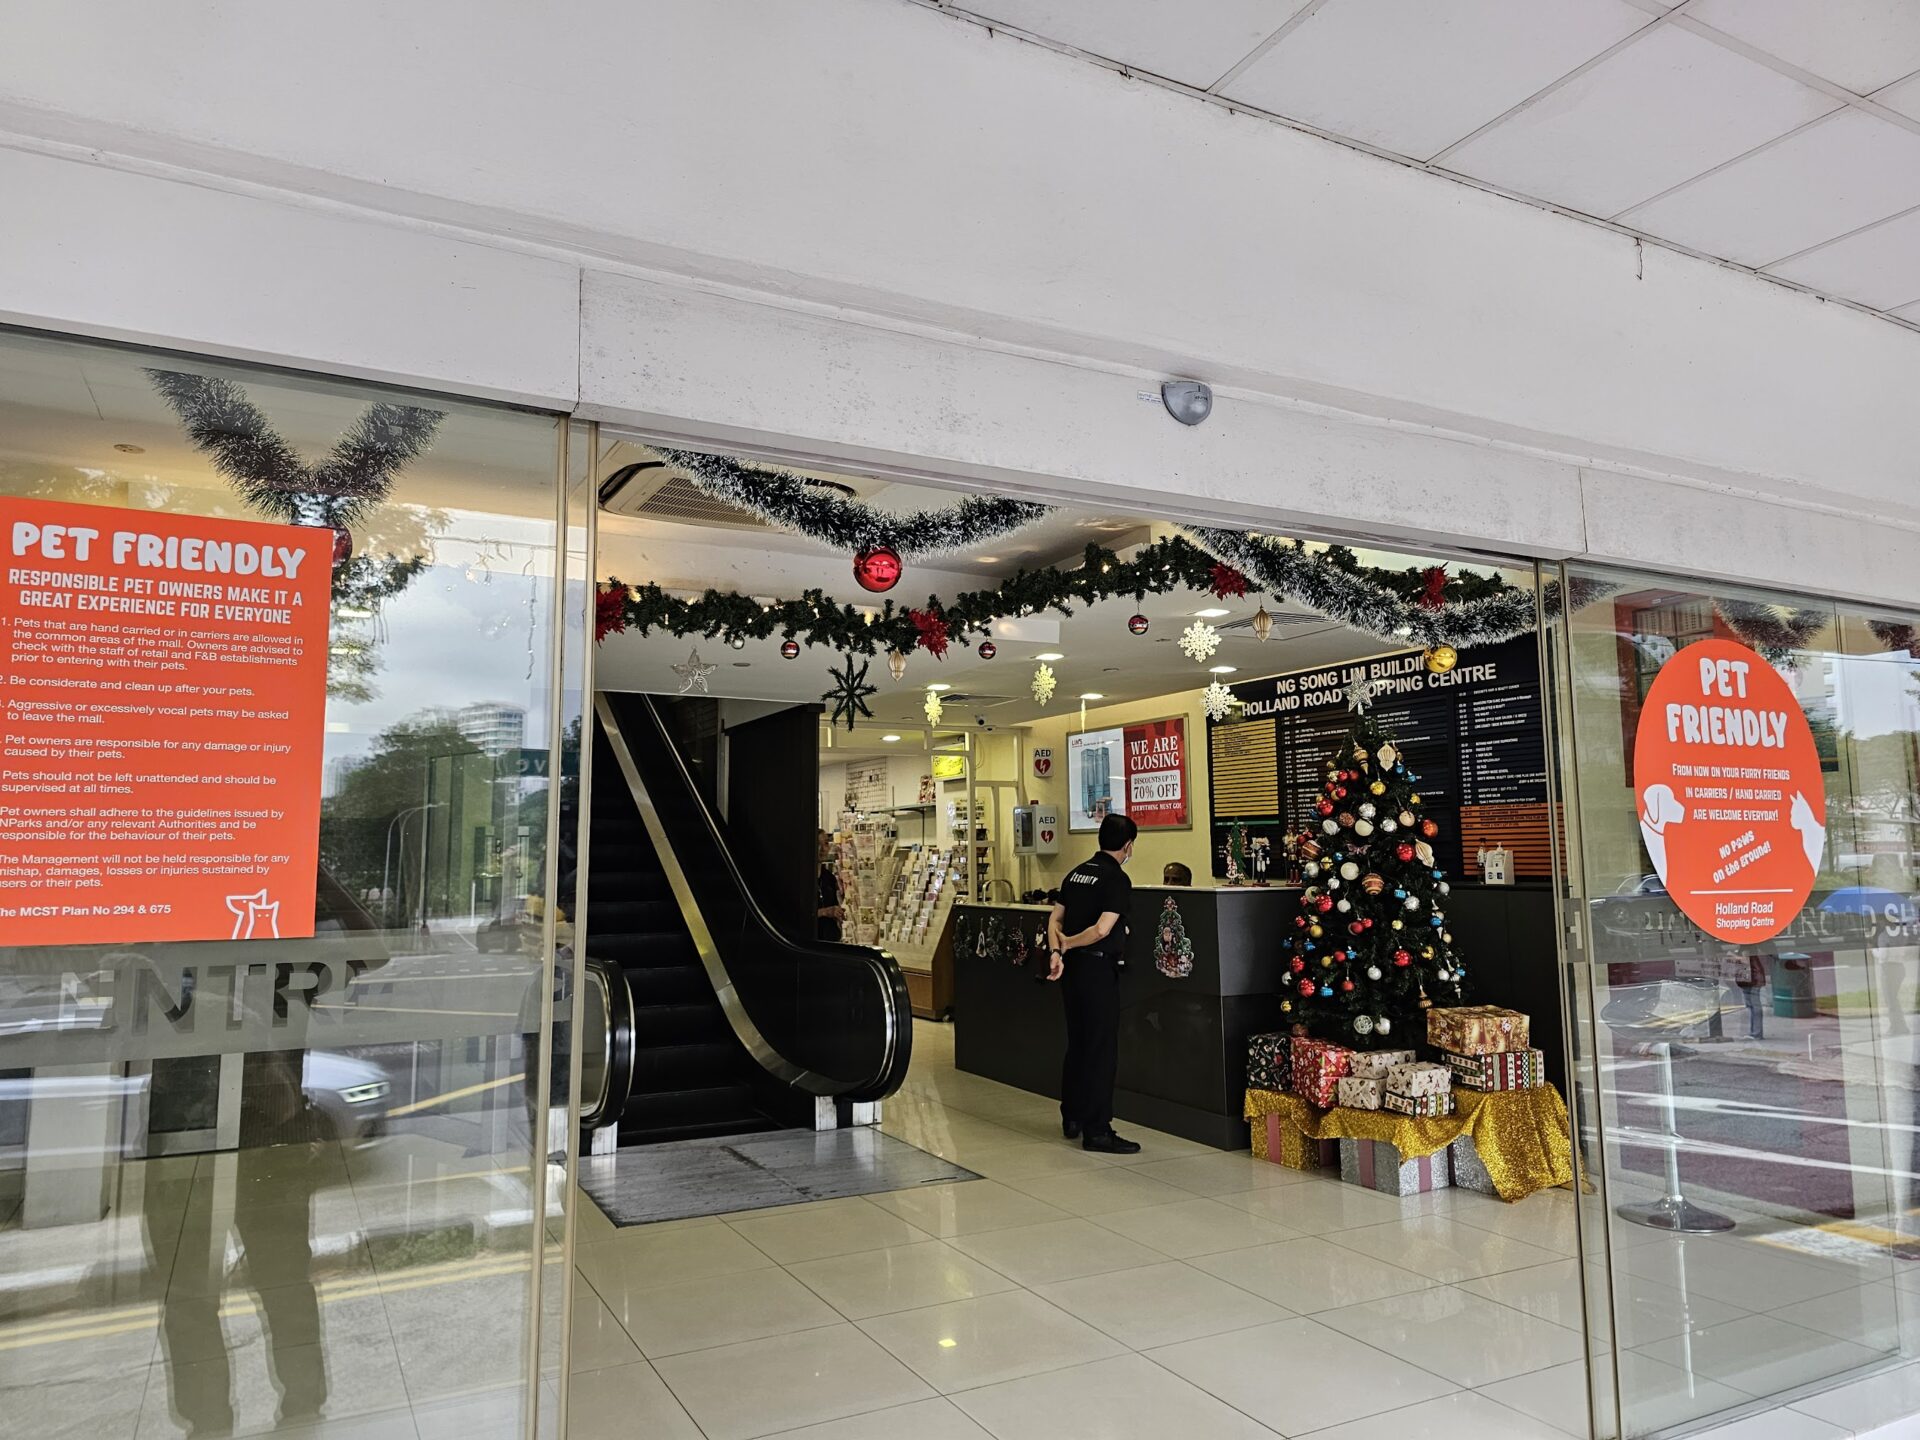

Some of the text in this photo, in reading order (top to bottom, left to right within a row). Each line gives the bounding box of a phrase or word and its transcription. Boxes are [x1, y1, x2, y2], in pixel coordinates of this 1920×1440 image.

[12, 521, 306, 579] PET FRIENDLY
[8, 568, 302, 606] RESPONSIBLE PET OWNERS MAKE IT A
[19, 589, 291, 624] GREAT EXPERIENCE FOR EVERYONE
[13, 617, 40, 628] Pets
[43, 619, 66, 629] that
[68, 622, 88, 631] are
[90, 622, 119, 633] hand
[121, 626, 160, 635] carried
[163, 628, 175, 636] or
[177, 628, 187, 637] in
[189, 630, 230, 640] carriers
[232, 633, 250, 641] are
[251, 633, 291, 644] allowed
[293, 636, 303, 644] in
[12, 628, 303, 655] the common areas of the mall. Owners are advised to
[10, 652, 188, 670] prior to entering with their pets.
[11, 640, 297, 665] check with the staff of retail and F&B establishments
[1276, 654, 1424, 695] NG SONG LIM BUILDI
[1699, 656, 1749, 698] PET
[9, 674, 26, 685] Be
[28, 677, 97, 688] considerate
[99, 680, 122, 689] and
[124, 681, 155, 691] clean
[157, 684, 172, 693] up
[174, 683, 200, 693] after
[202, 686, 227, 695] your
[228, 687, 255, 696] pets.
[1241, 662, 1498, 717] HOLLAND ROAD OPPING CENTRE
[6, 711, 105, 723] to leave the mall.
[7, 698, 72, 711] Aggressive
[74, 703, 88, 711] or
[89, 704, 155, 716] excessively
[156, 706, 187, 715] vocal
[189, 707, 214, 717] pets
[215, 709, 239, 719] may
[240, 708, 255, 718] be
[256, 710, 288, 719] asked
[1665, 702, 1787, 748] FRIENDLY
[3, 747, 126, 759] caused by their pets.
[4, 734, 291, 754] Pet owners are responsible for any damage or injury
[1034, 749, 1051, 757] AED
[1130, 739, 1149, 756] WE
[1152, 735, 1179, 753] ARE
[1130, 751, 1180, 771] CLOSING
[1133, 775, 1161, 785] DISCOUNTS
[1161, 774, 1170, 782] UP
[1671, 763, 1790, 780] FROM NOW ON YOUR FURRY FRIENDS
[0, 783, 134, 793] supervised at all times.
[1133, 783, 1179, 800] 70% OFF
[1685, 786, 1693, 797] IN
[1693, 787, 1728, 799] CARRIERS
[1734, 788, 1753, 800] HAND
[1753, 789, 1781, 800] CARRIED
[1131, 803, 1159, 812] EVERYTHING
[1159, 802, 1172, 811] MUST
[1692, 808, 1778, 821] ARE WELCOME EVERYDAY!
[1038, 816, 1056, 824] AED
[21, 854, 99, 865] Management
[101, 854, 120, 863] will
[123, 854, 142, 863] not
[144, 854, 160, 863] be
[161, 853, 186, 863] held
[188, 853, 251, 864] responsible
[253, 853, 268, 862] for
[270, 855, 290, 864] any
[1718, 844, 1731, 859] NO
[1712, 840, 1772, 884] on the ground!
[0, 904, 171, 916] he MCST Plan No 294 & 675
[1715, 901, 1773, 915] Holland Road
[1715, 916, 1774, 929] Shopping Centre
